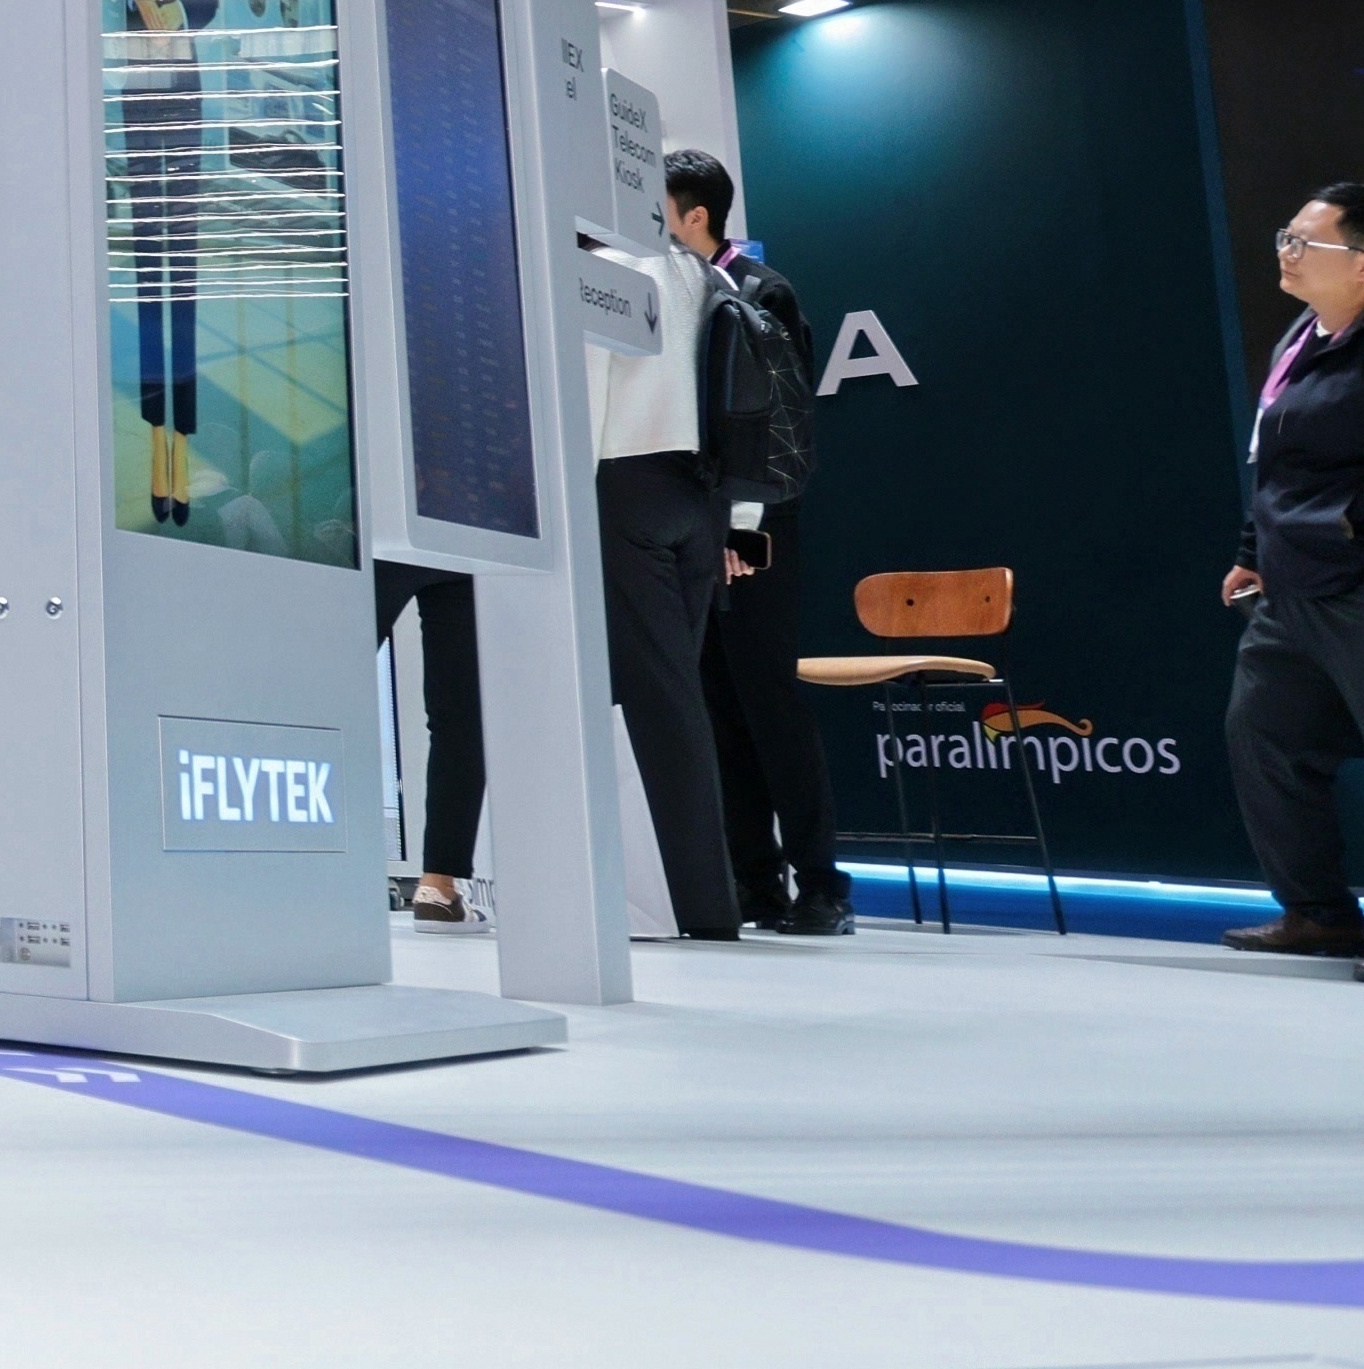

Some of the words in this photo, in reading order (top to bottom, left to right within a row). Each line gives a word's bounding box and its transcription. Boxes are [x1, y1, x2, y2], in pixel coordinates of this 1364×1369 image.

[610, 93, 648, 133] GuideX
[611, 124, 657, 169] Telecom
[615, 157, 645, 194] Kiosk
[579, 277, 632, 318] eception
[935, 701, 966, 712] oficial
[179, 749, 335, 823] iFLYTEK
